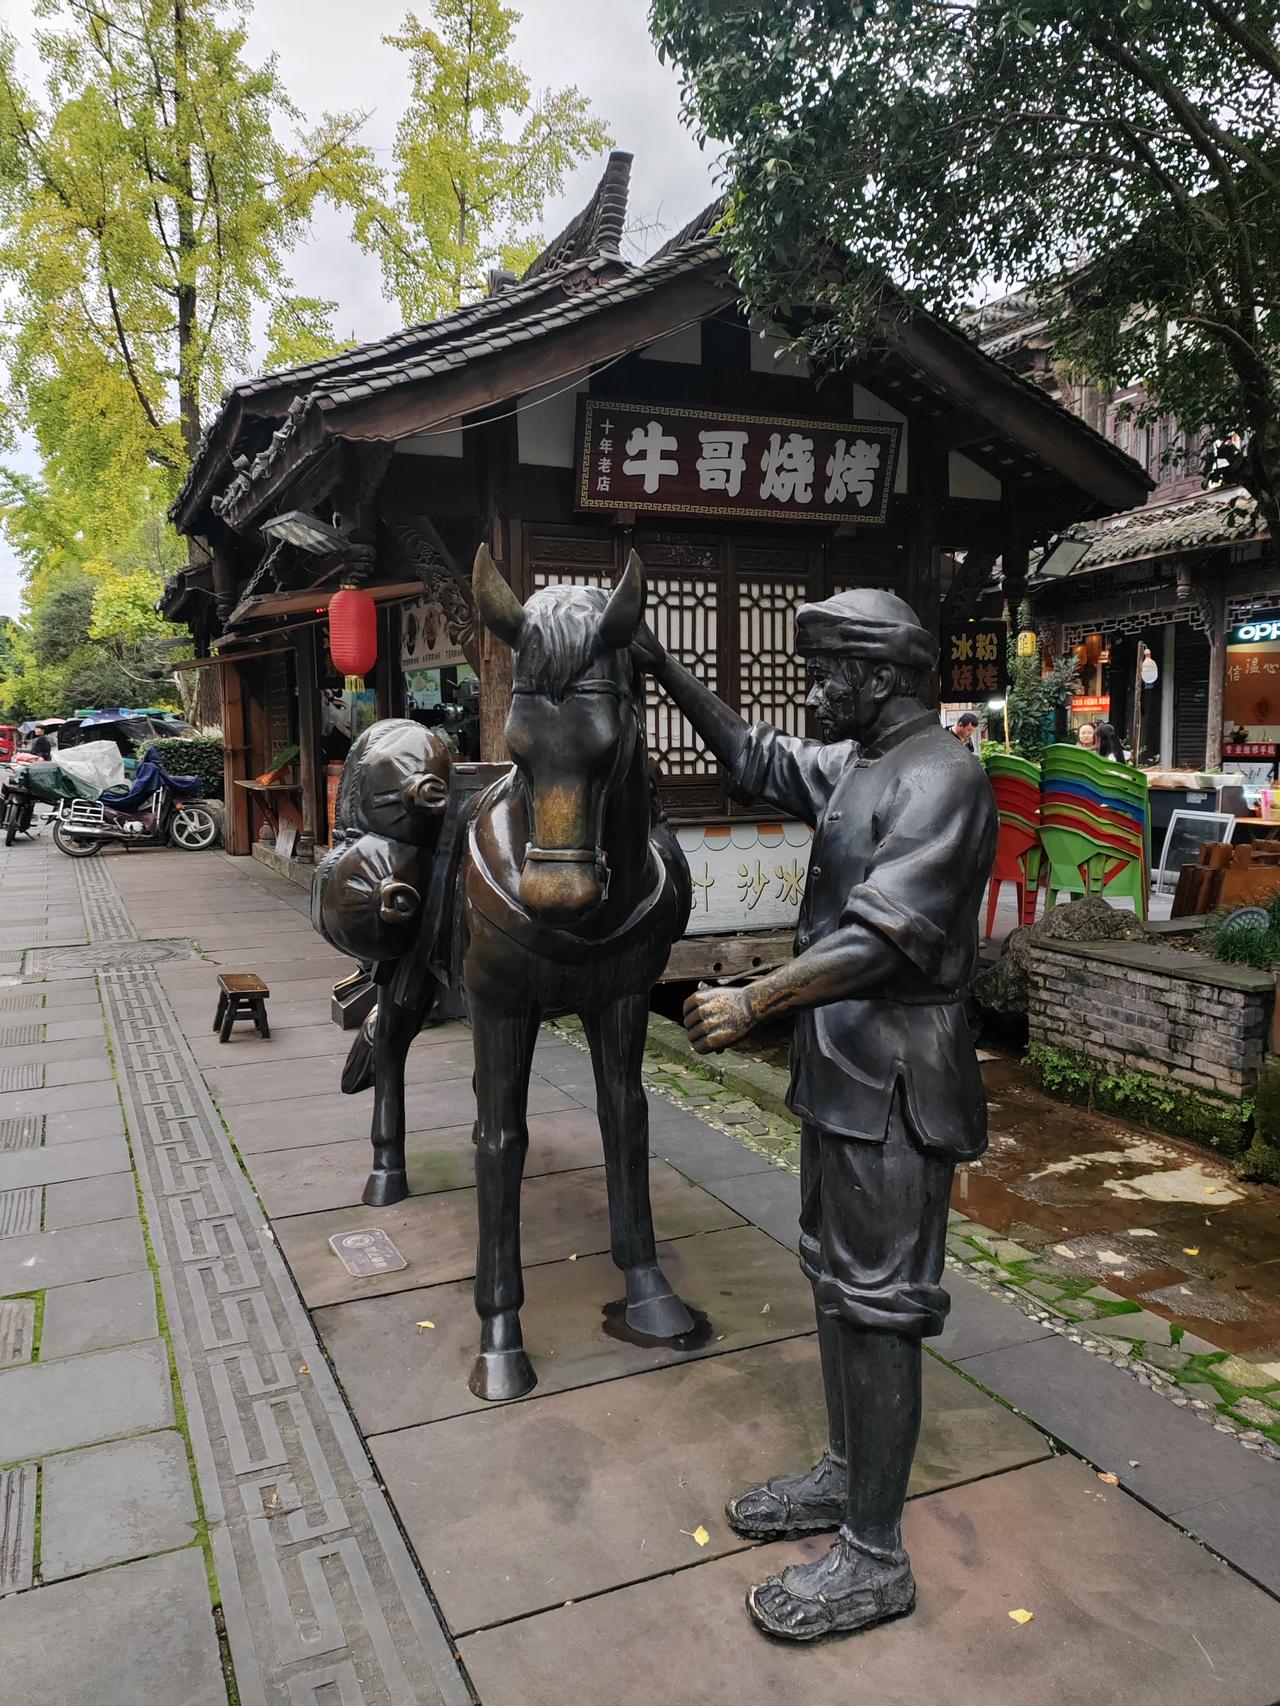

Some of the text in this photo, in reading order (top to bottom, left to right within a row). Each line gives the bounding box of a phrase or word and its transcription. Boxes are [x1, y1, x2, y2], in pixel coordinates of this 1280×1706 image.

[597, 418, 615, 492] 十年老店
[622, 420, 881, 508] 牛哥烧烤
[950, 632, 998, 661] 冰粉
[950, 663, 999, 692] 烧烤
[737, 858, 806, 910] 沙冰
